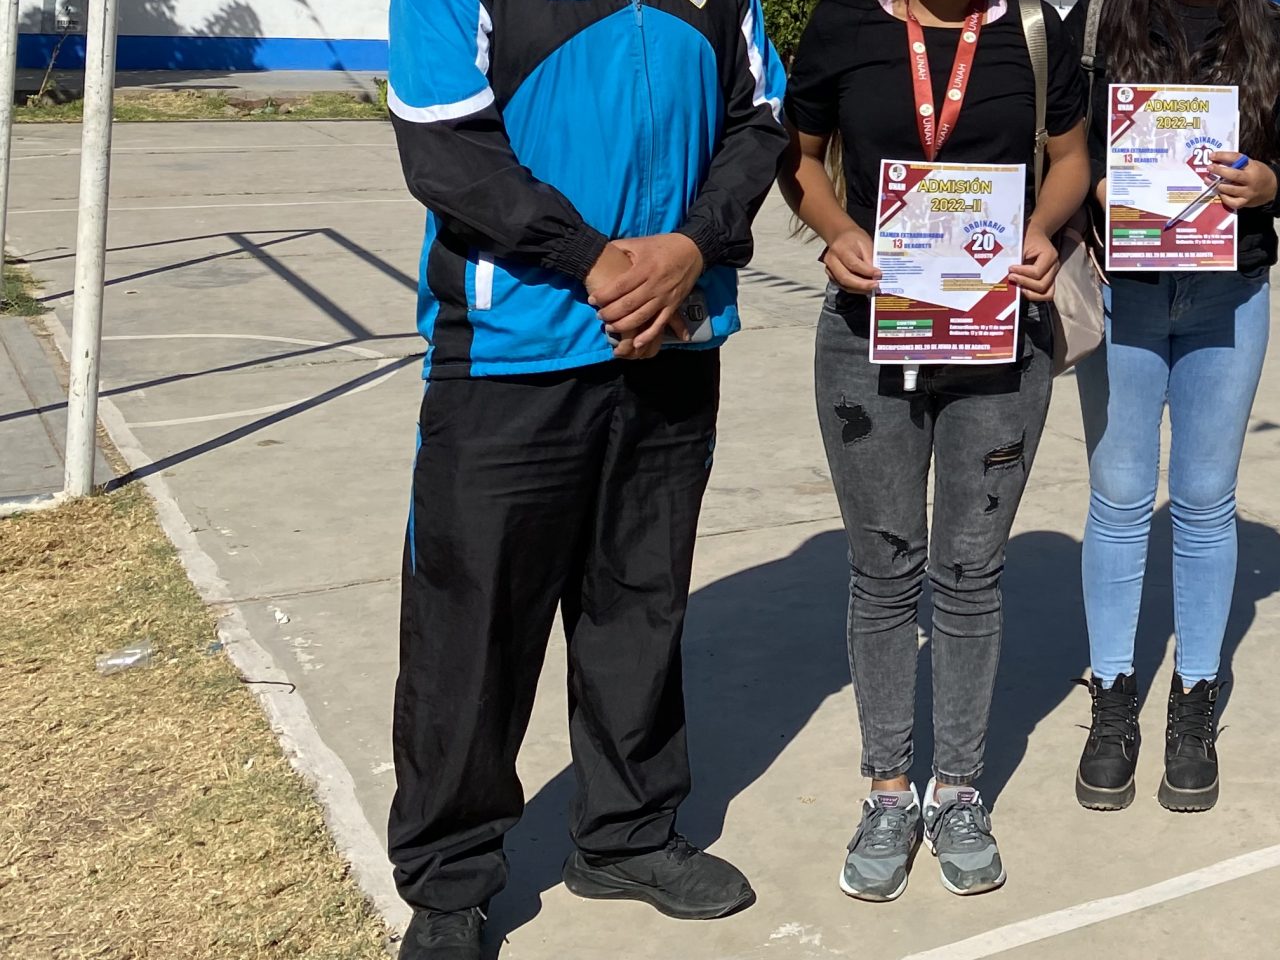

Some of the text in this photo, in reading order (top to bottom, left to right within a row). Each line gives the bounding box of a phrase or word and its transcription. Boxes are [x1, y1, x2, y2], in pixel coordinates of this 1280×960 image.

[916, 55, 927, 81] UNAH
[953, 63, 967, 89] UNAH
[1144, 97, 1209, 113] ADMISIÓN
[922, 117, 932, 145] UNAH
[1156, 116, 1201, 130] 2022-II
[1185, 136, 1223, 149] ORDINARIO
[917, 177, 993, 194] ADMISIÓN
[931, 198, 982, 213] 2022-II
[964, 220, 1006, 234] ORDINARIO
[892, 239, 903, 249] 13
[972, 232, 996, 251] 20
